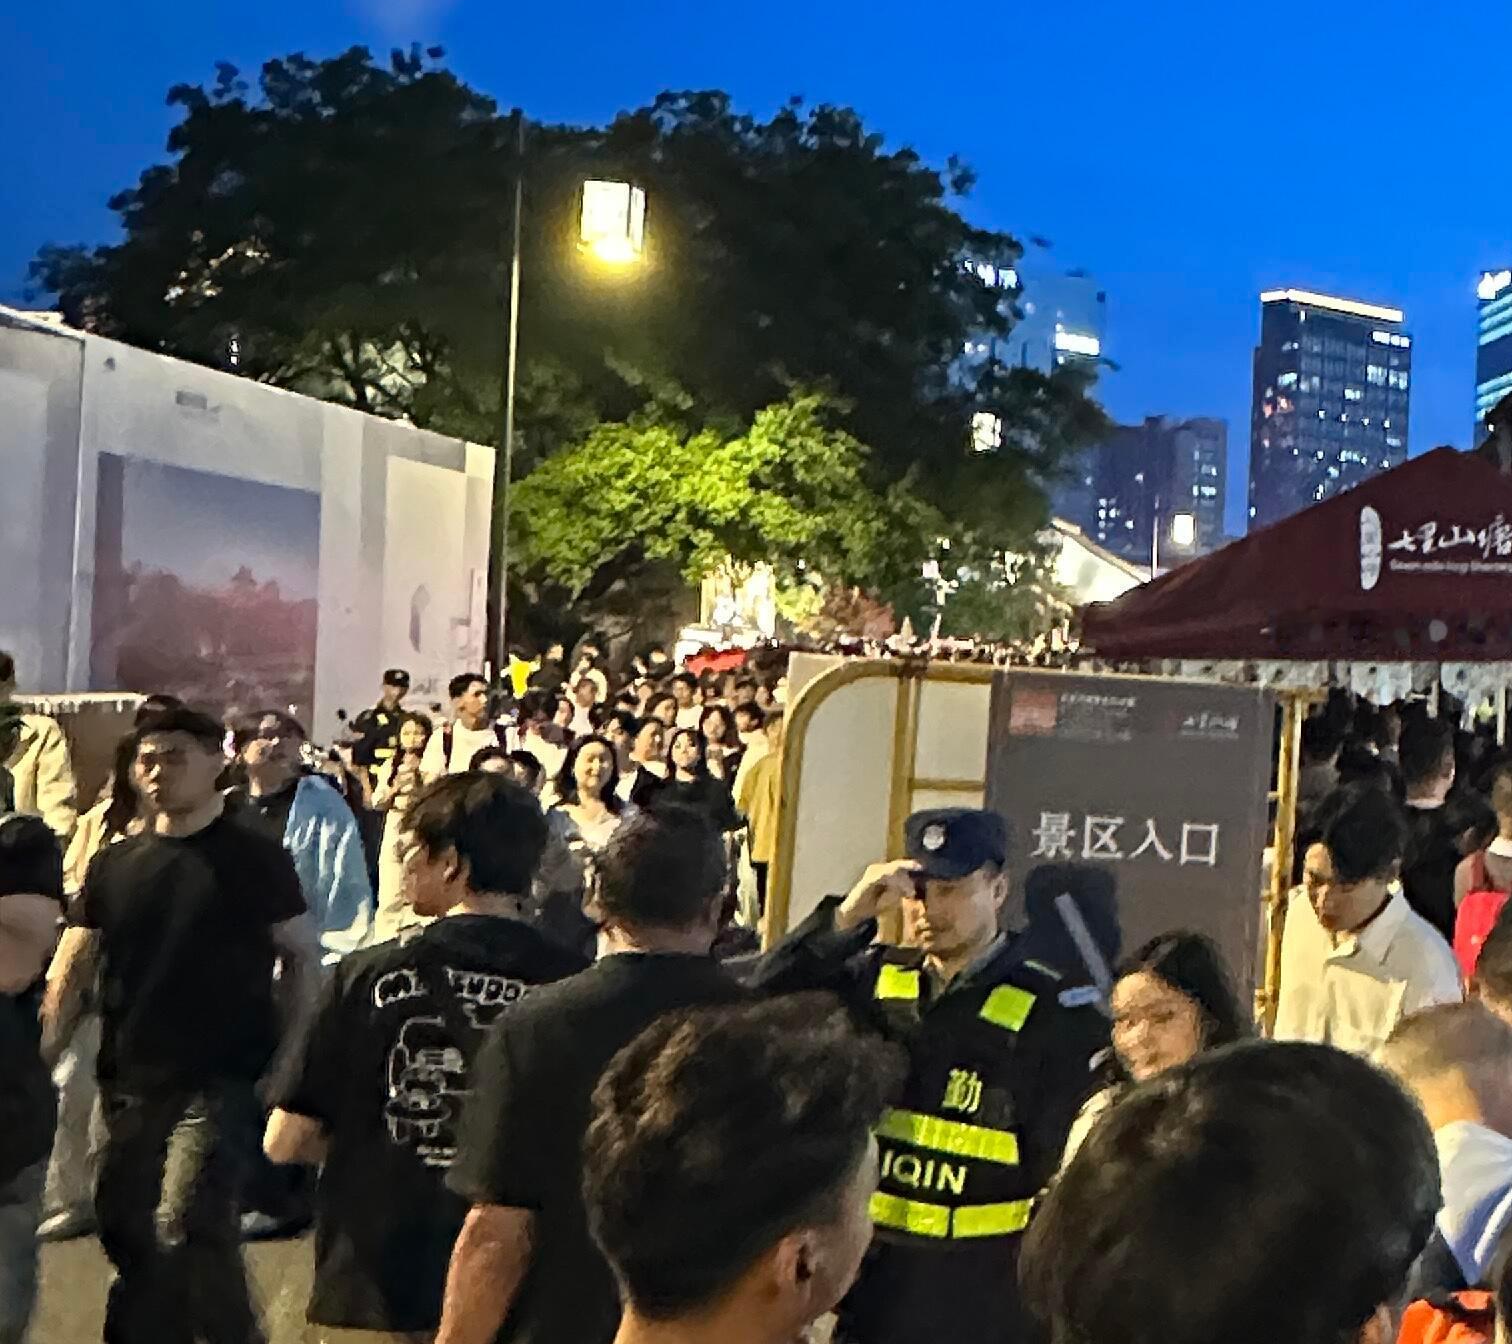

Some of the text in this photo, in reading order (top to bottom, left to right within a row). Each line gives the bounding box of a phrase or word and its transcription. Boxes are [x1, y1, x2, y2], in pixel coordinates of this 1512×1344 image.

[1029, 811, 1220, 866] 景区入口
[942, 1068, 983, 1113] 勤
